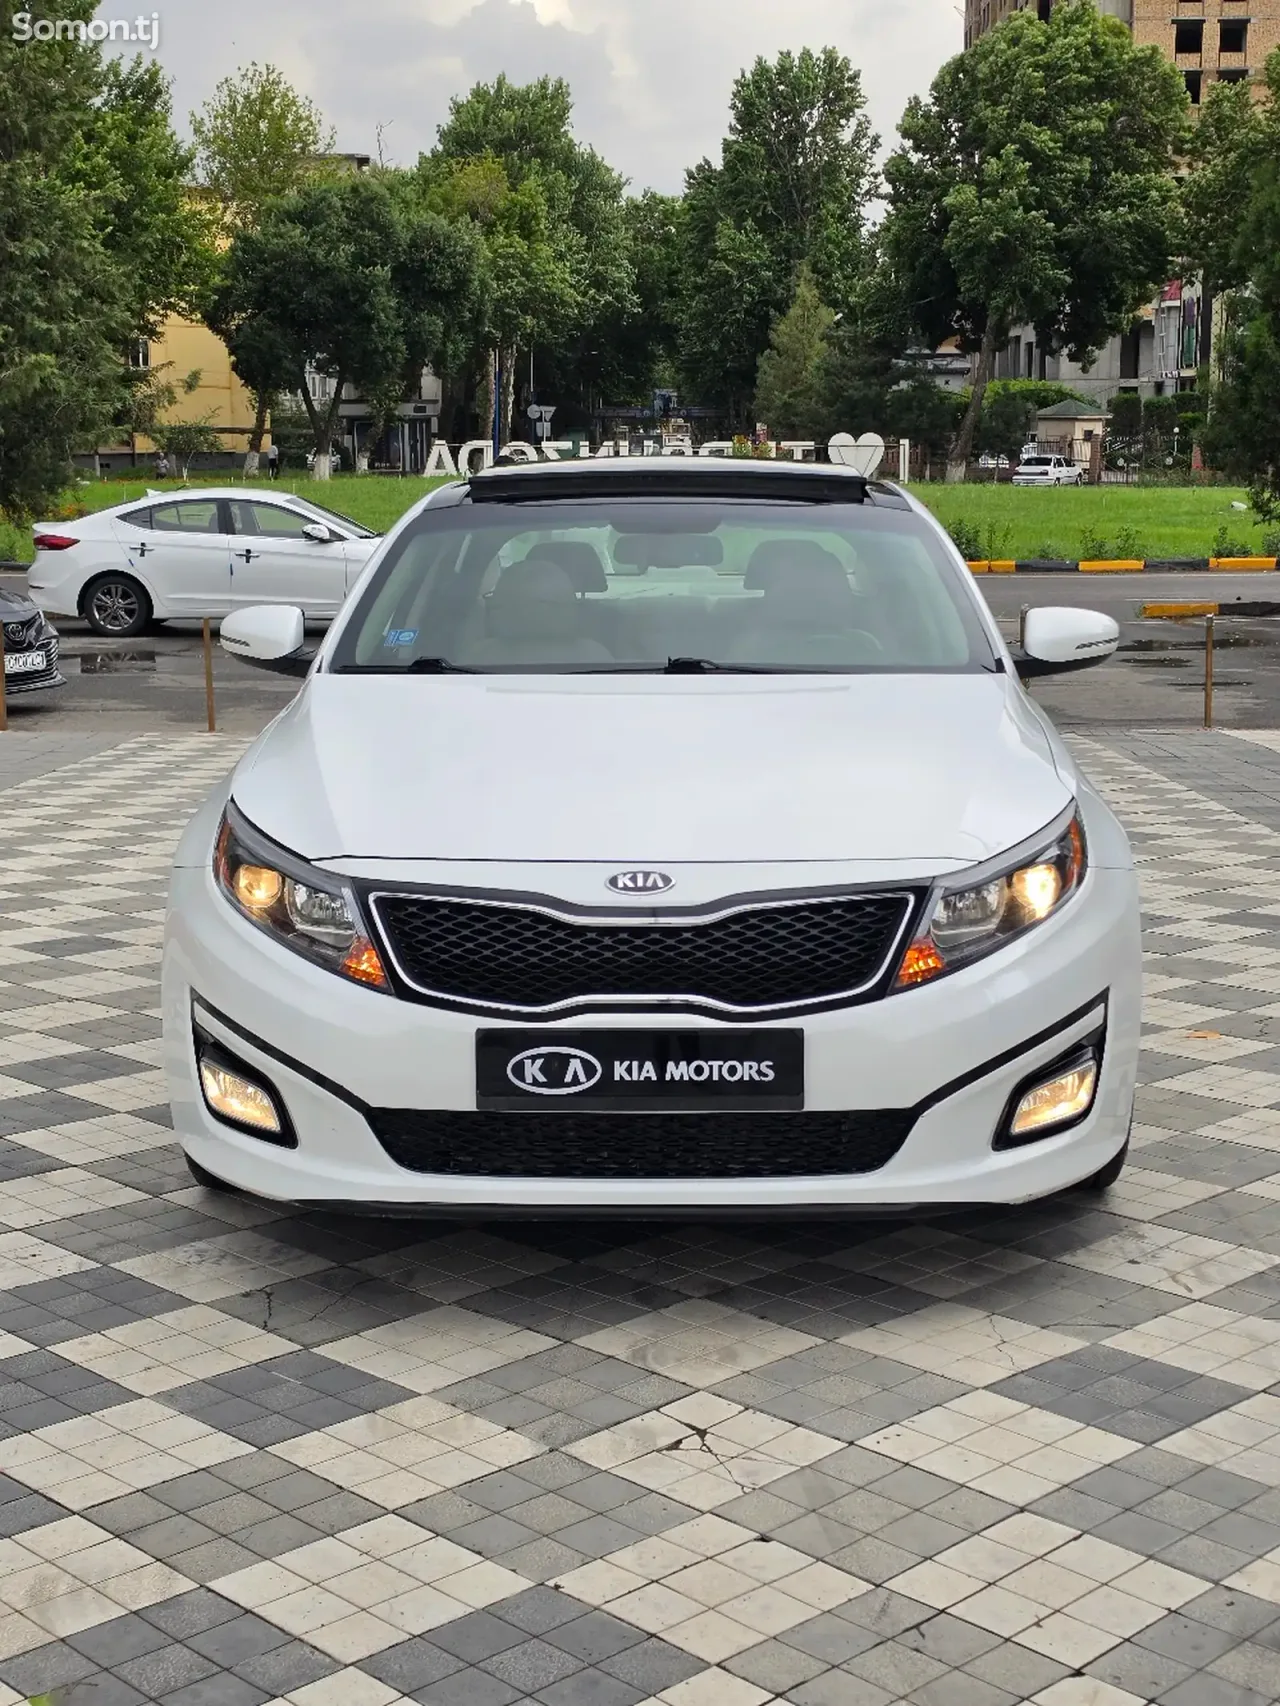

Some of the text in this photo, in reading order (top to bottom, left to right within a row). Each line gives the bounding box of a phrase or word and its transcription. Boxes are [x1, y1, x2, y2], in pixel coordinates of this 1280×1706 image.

[616, 873, 664, 887] KIA
[613, 1060, 657, 1081] KIA
[665, 1060, 775, 1082] MOTORS
